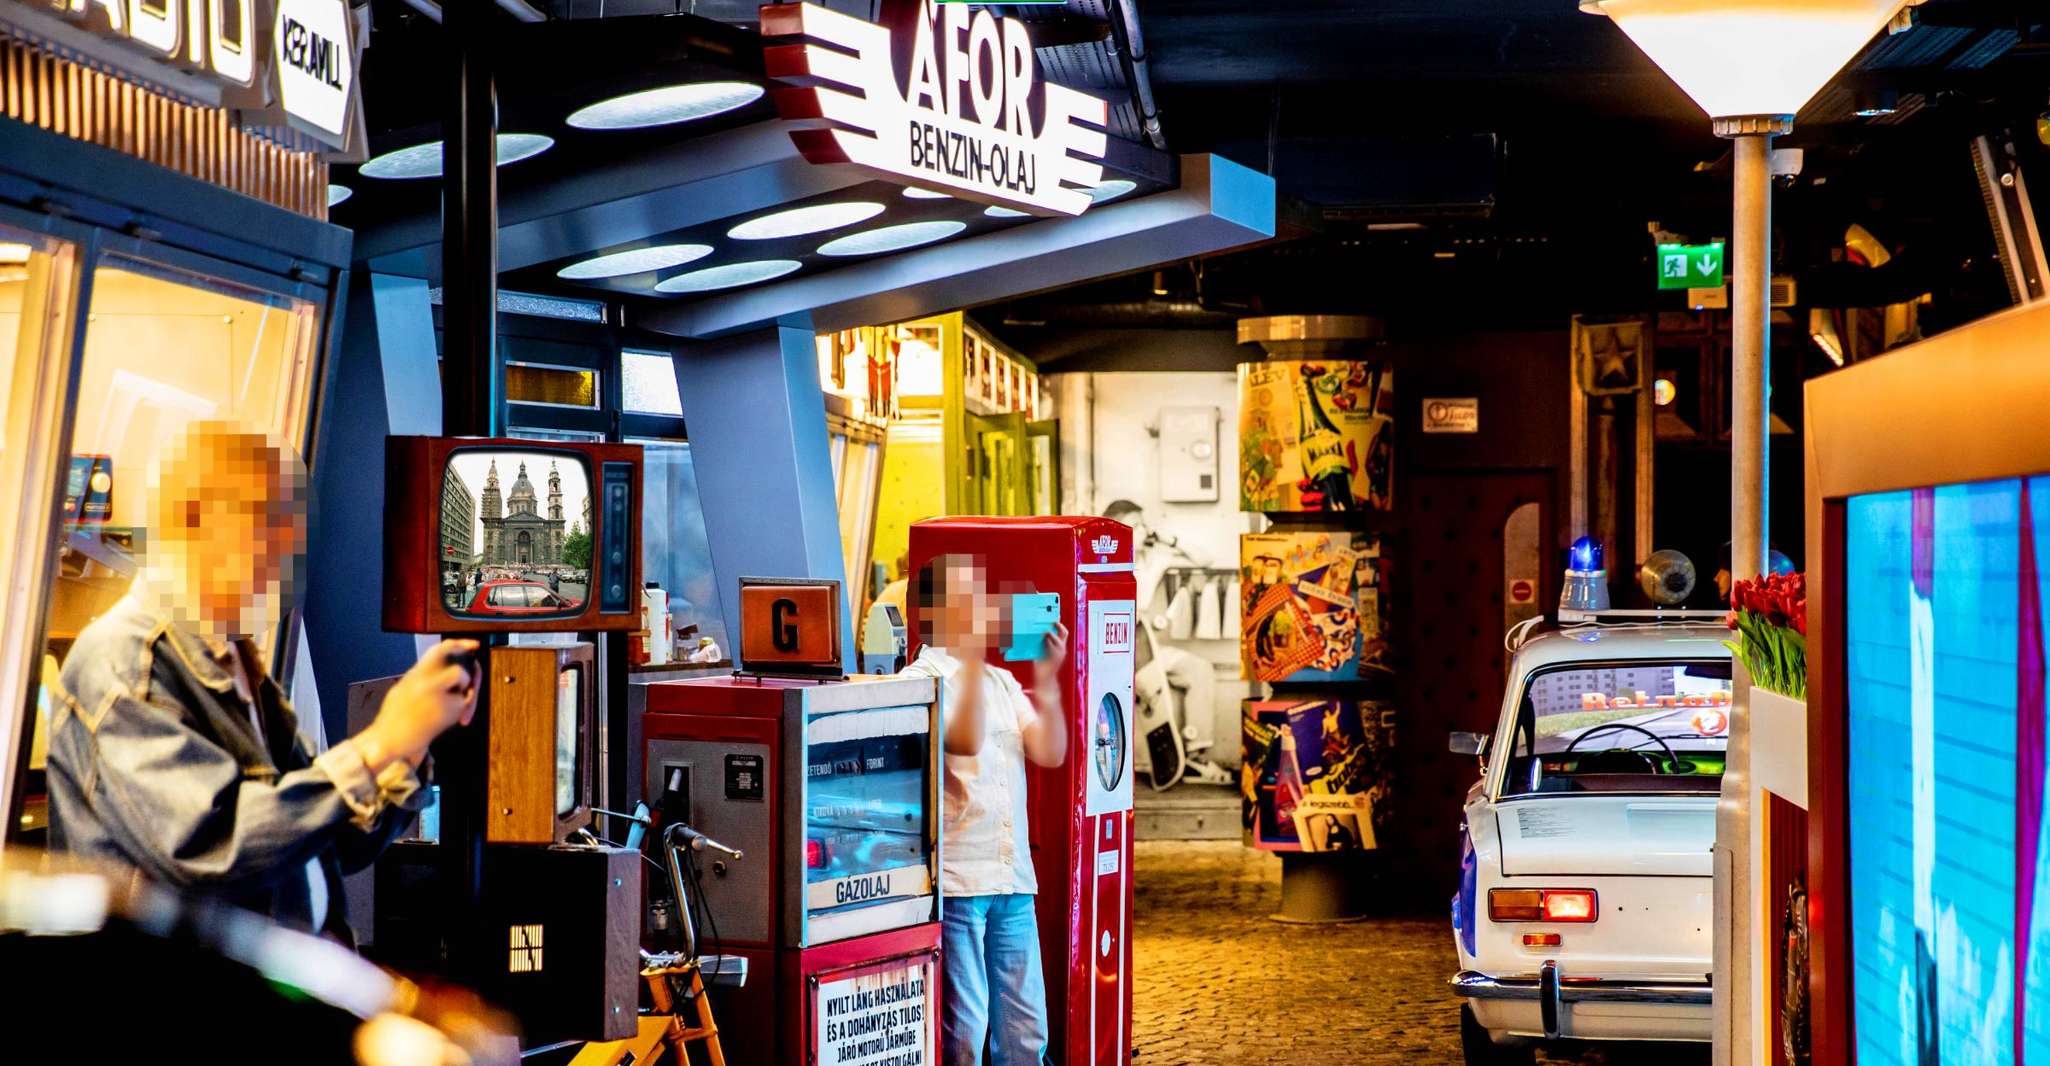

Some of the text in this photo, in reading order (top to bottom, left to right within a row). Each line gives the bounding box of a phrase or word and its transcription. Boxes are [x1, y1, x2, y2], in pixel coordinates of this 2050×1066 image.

[910, 120, 1036, 195] BENZIN-OLAJ
[772, 598, 799, 654] G
[1105, 623, 1128, 645] BENZIN
[866, 757, 885, 769] FORINT
[836, 874, 890, 903] GÁZOLAJ
[827, 977, 925, 1017] NYILT LÁNG HASZNÁLATA
[827, 1004, 925, 1042] ÉS A DOHÁNYZÁS TILOS!
